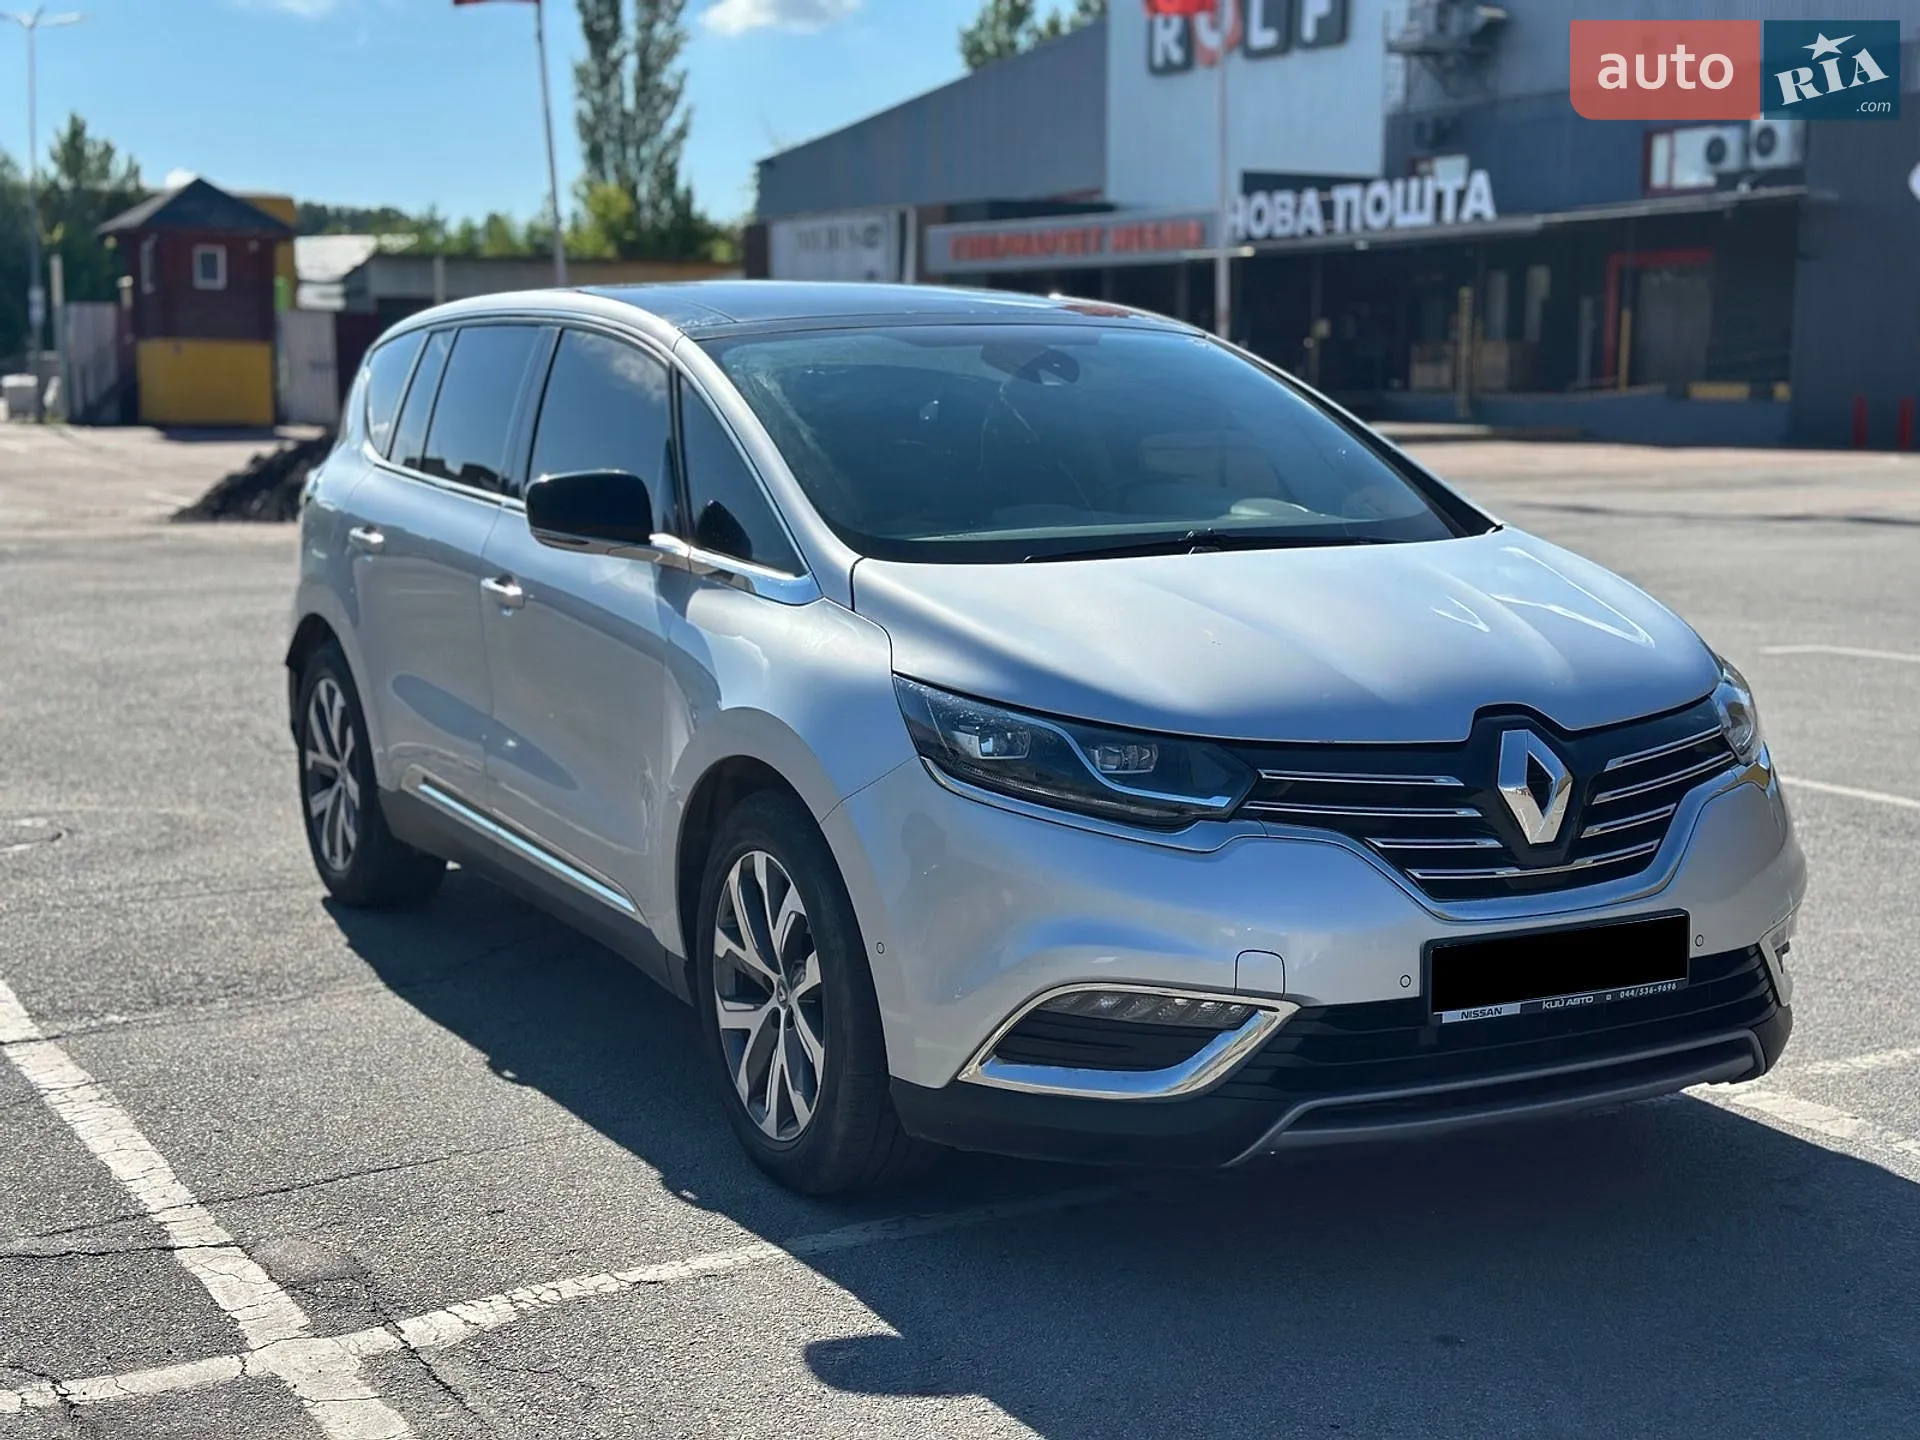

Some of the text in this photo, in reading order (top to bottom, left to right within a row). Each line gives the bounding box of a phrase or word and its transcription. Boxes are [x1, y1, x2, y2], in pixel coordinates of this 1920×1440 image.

[1227, 188, 1325, 241] НОВА
[1331, 170, 1497, 235] ПОШТА
[1461, 1007, 1503, 1019] NISSAN
